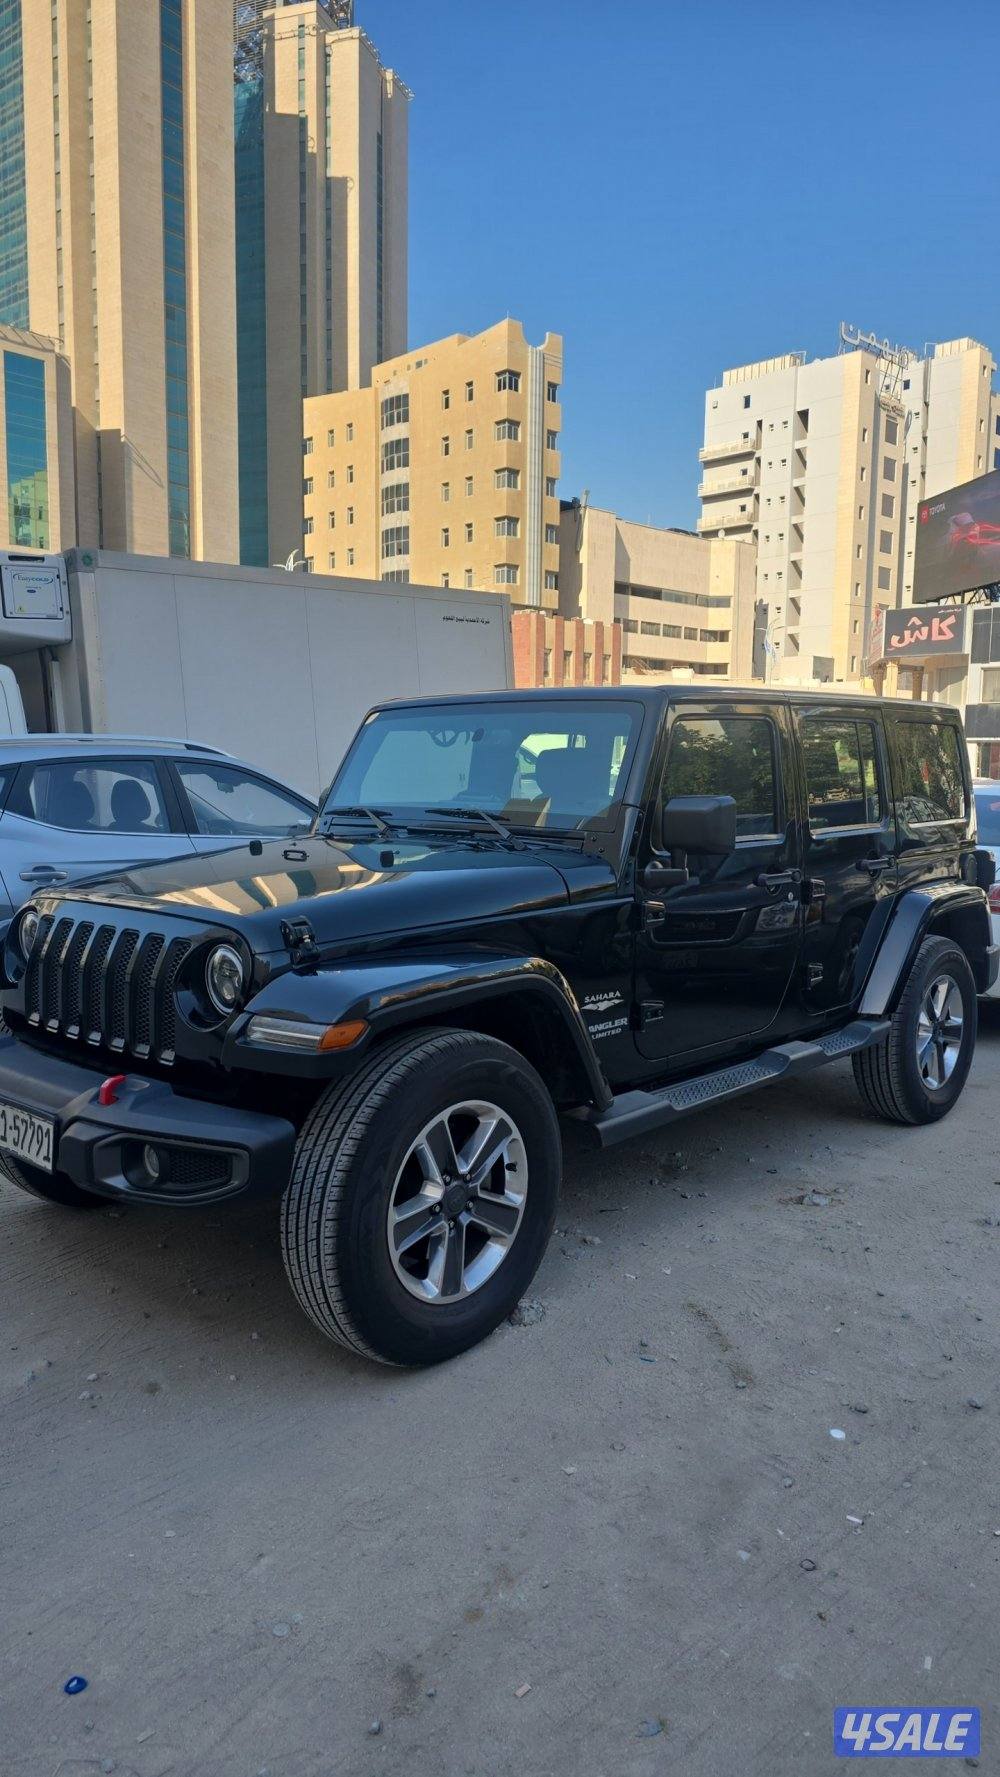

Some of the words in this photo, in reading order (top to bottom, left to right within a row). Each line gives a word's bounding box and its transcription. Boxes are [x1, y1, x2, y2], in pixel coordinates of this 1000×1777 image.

[929, 503, 946, 516] TOYOTA
[584, 990, 621, 1003] SAHARA
[588, 1017, 628, 1033] ANGLER
[591, 1027, 622, 1040] LIMITED
